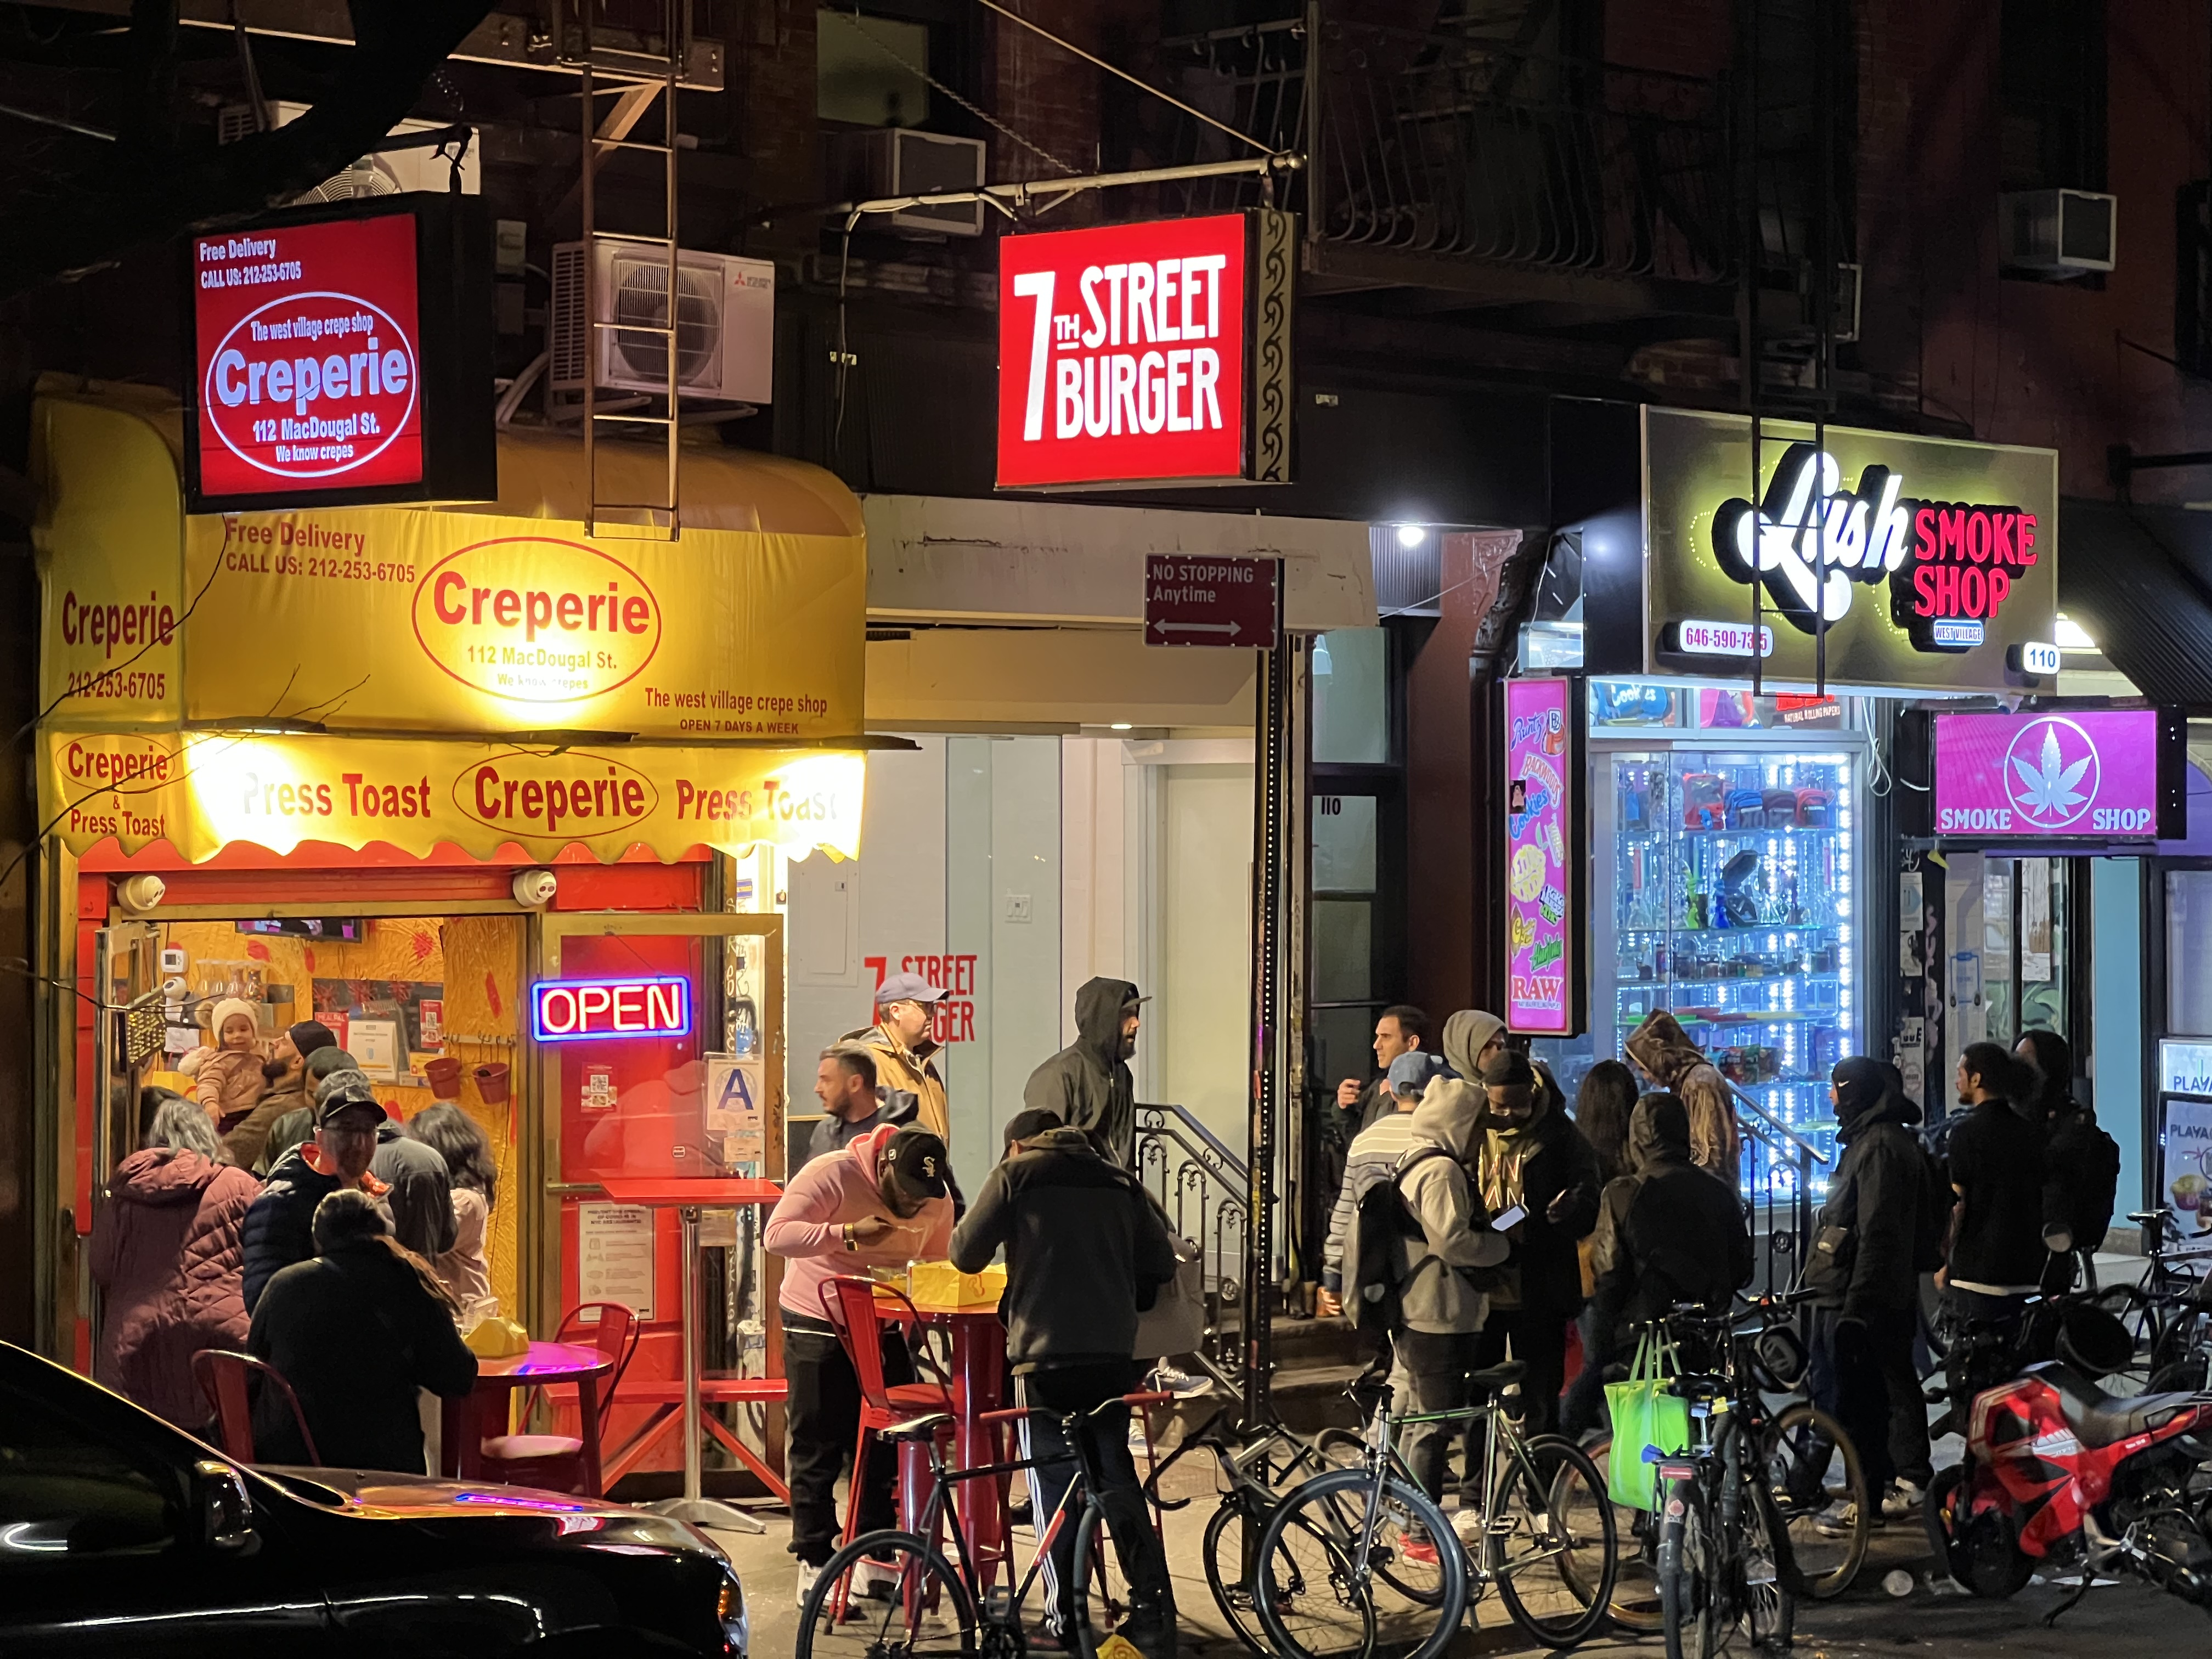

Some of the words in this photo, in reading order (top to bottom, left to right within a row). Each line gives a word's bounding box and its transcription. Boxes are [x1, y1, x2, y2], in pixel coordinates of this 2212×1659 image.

[200, 242, 226, 262] Free
[228, 238, 276, 259] Delivery
[201, 269, 225, 289] CALL
[226, 268, 242, 286] US:
[244, 261, 302, 285] 212-253-6705
[1080, 255, 1226, 349] STREET
[250, 320, 268, 341] The
[269, 319, 292, 340] west
[293, 317, 323, 341] village
[324, 317, 350, 338] crepe
[352, 311, 374, 336] shop
[215, 337, 408, 416] Creperie
[1057, 347, 1223, 439] BURGER
[253, 419, 276, 442] 112
[281, 413, 357, 442] MacDougal
[360, 412, 380, 435] St.
[275, 445, 291, 462] We
[292, 445, 319, 461] know
[320, 444, 353, 462] crepes
[226, 518, 273, 544] Free
[281, 522, 365, 557] Delivery
[1736, 451, 1909, 622] Lush
[1914, 508, 2038, 566] SMOKE
[226, 552, 270, 573] CALL
[275, 556, 303, 575] US:
[308, 557, 415, 583] 212-253-6705
[1153, 564, 1175, 580] NO
[1180, 565, 1254, 583] STOPPING
[433, 571, 651, 642] Creperie
[1153, 585, 1216, 605] Anytime
[1914, 565, 2010, 618] SHOP
[63, 590, 174, 659] Creperie
[1686, 627, 1768, 651] 646-590-735
[1935, 627, 1954, 639] WEST
[1955, 628, 1982, 640] VILLAGE
[467, 645, 496, 664] 112
[503, 647, 590, 672] MacDougal
[597, 651, 617, 669] St.
[2030, 648, 2056, 668] 110
[68, 670, 165, 700] 212-253-6705
[497, 673, 514, 686] We
[645, 687, 670, 707] The
[674, 690, 706, 709] west
[710, 690, 753, 715] village
[757, 695, 793, 716] crepe
[798, 693, 827, 718] shop
[680, 719, 711, 731] OPEN
[714, 720, 721, 731] 7
[725, 721, 752, 732] DAYS
[756, 722, 764, 733] A
[767, 722, 799, 735] WEEK
[68, 742, 167, 786] Creperie
[113, 795, 121, 810] &
[244, 772, 332, 817] Press
[342, 773, 431, 819] Toast
[475, 766, 645, 832] Creperie
[676, 779, 752, 821] Press
[1321, 797, 1341, 815] 110
[71, 808, 117, 834] Press
[122, 811, 166, 837] Toast
[1941, 809, 2012, 830] SMOKE
[2092, 809, 2151, 831] SHOP
[1512, 977, 1561, 1000] RAW
[541, 984, 680, 1034] OPEN
[716, 1068, 754, 1110] A
